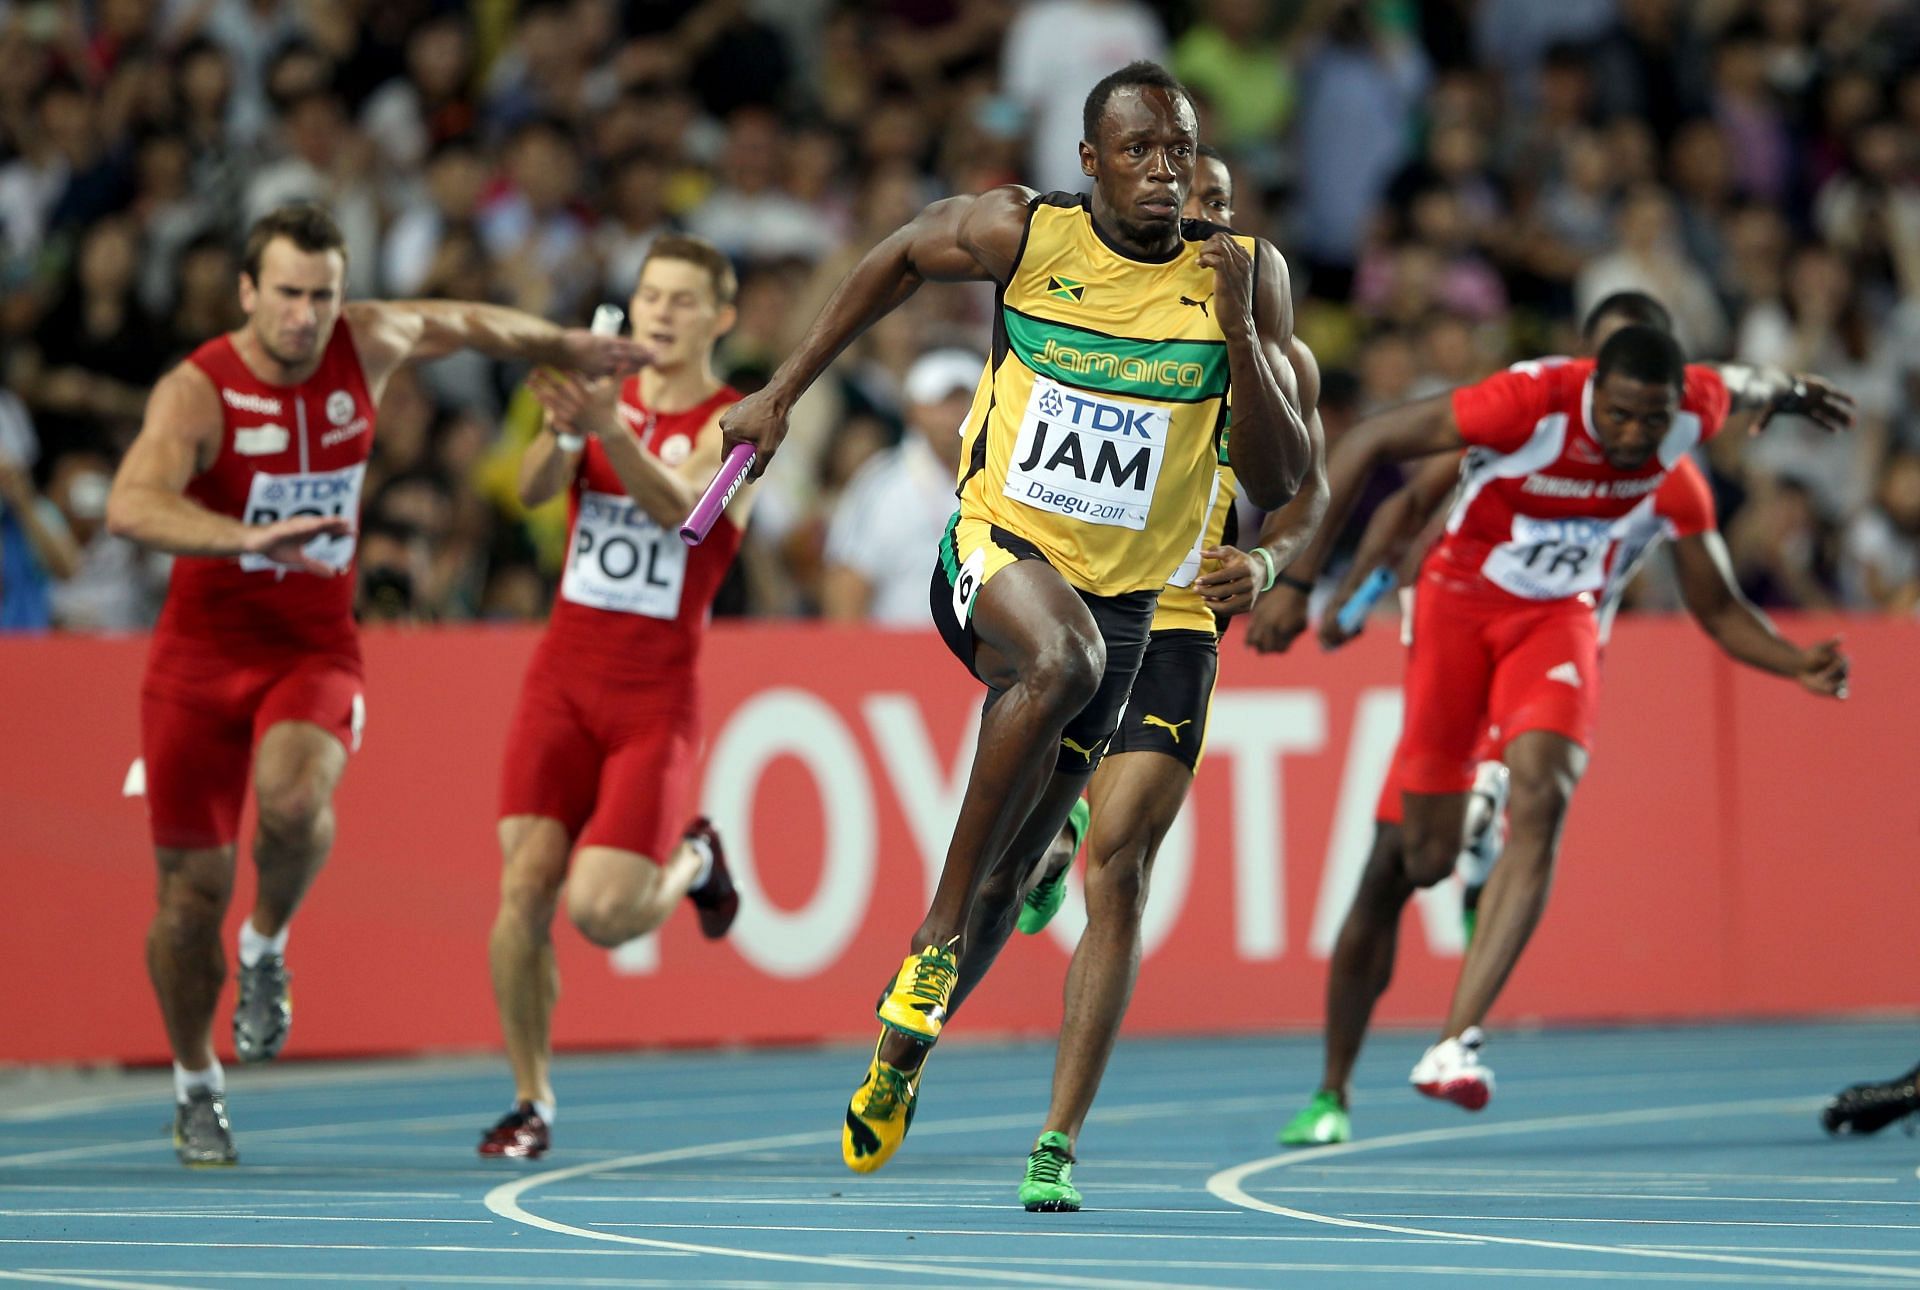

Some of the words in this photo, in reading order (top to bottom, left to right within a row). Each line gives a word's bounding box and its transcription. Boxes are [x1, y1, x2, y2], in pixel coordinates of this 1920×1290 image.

[1031, 338, 1204, 388] Jamaica
[1064, 394, 1155, 440] TDK
[1018, 420, 1152, 492] JAM
[289, 475, 352, 500] TDK
[1026, 481, 1090, 514] Daegu
[1090, 504, 1126, 521] 2011
[574, 529, 670, 588] POL
[960, 569, 974, 605] 6
